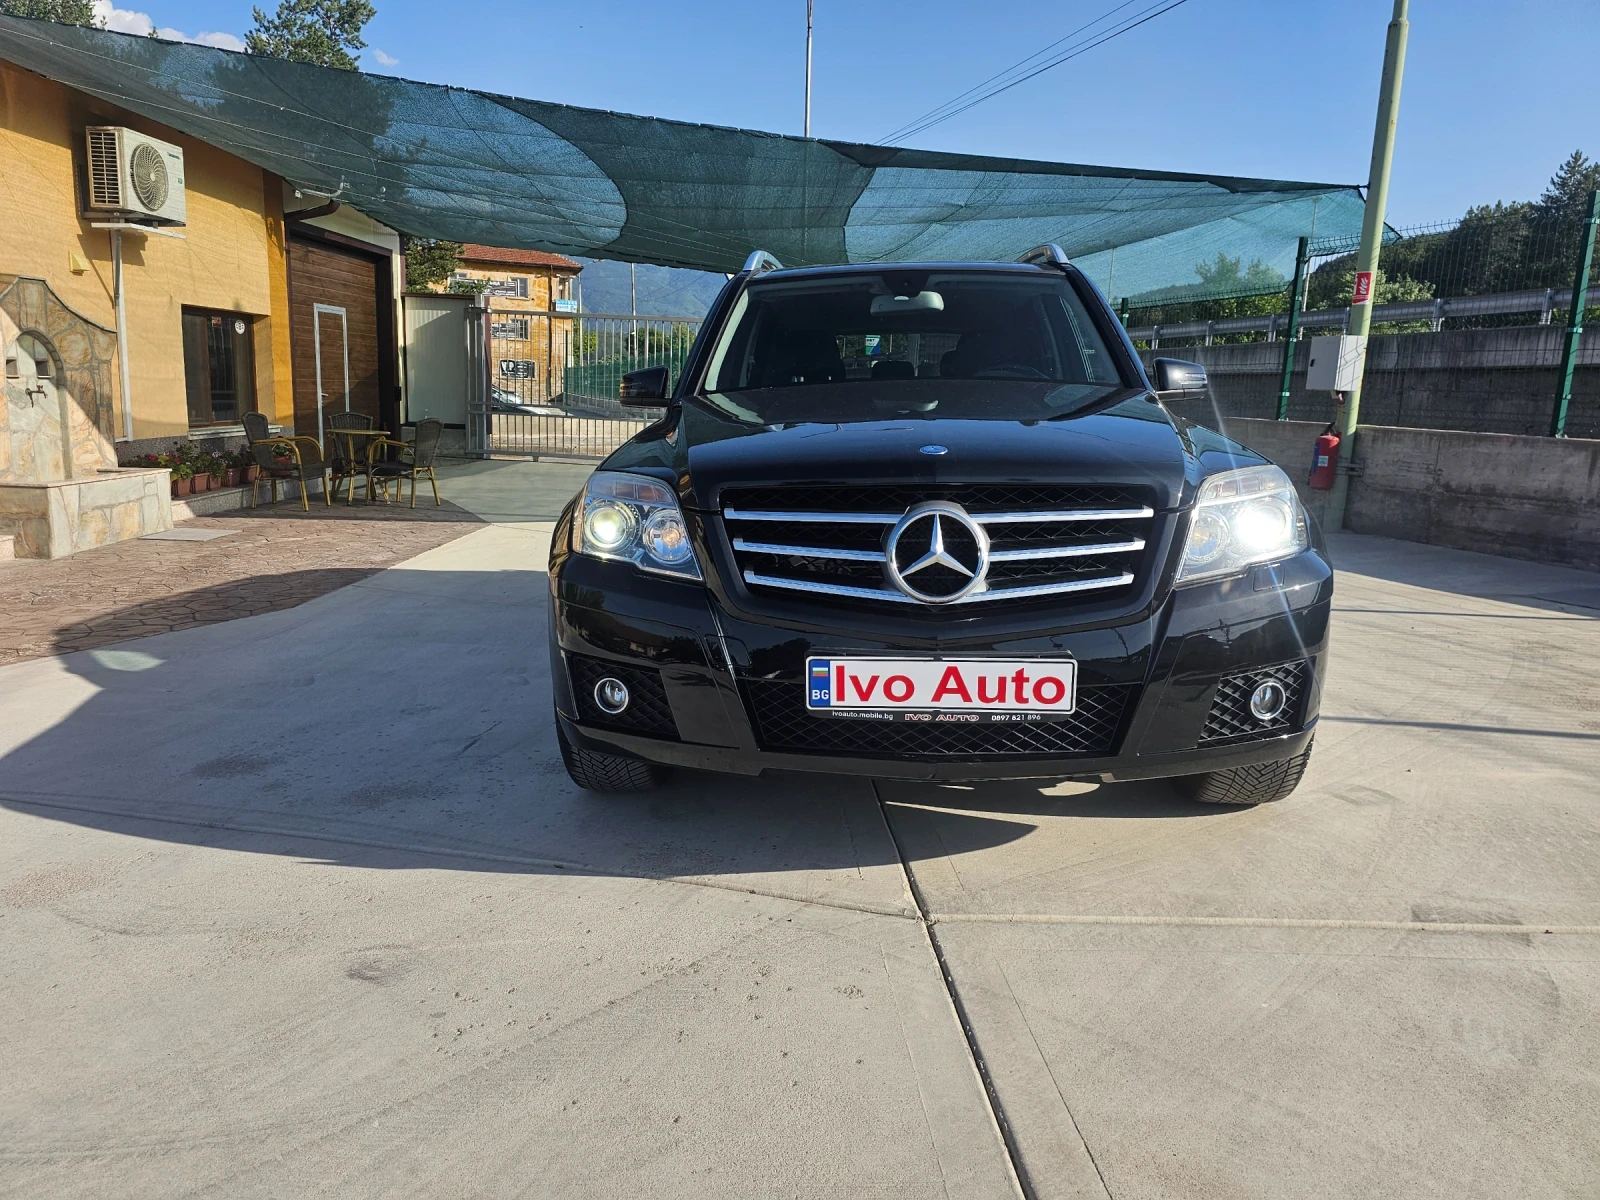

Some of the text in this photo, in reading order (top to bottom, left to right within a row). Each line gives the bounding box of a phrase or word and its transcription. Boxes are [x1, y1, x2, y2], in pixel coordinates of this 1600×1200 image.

[835, 665, 1066, 704] Ivo Auto
[812, 690, 829, 699] BG
[832, 710, 893, 720] ivoauto.mobile.bg
[904, 713, 980, 722] IVO AUTO
